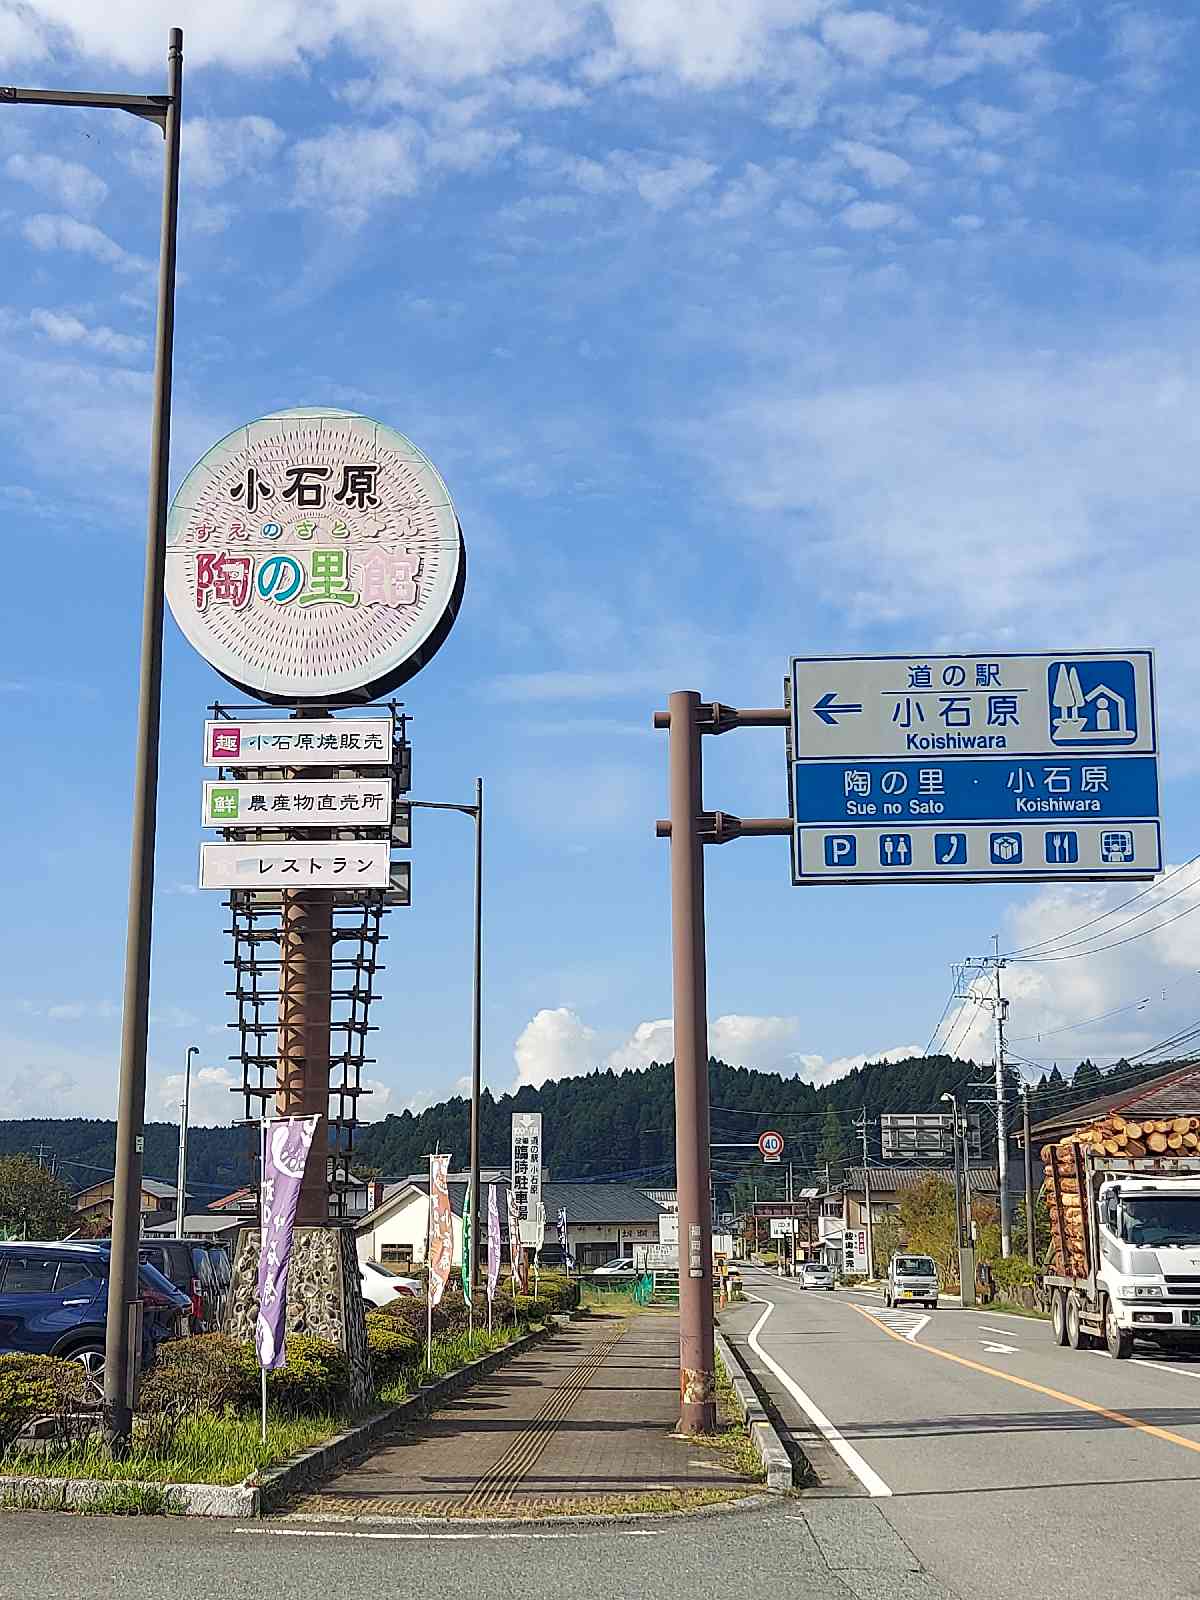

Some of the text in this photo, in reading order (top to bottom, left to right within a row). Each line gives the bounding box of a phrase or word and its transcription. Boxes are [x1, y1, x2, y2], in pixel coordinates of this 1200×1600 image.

[230, 464, 383, 510] 小石原
[908, 663, 1001, 689] 道の駅
[892, 695, 1020, 728] 小石原
[249, 733, 384, 751] 小石原焼販売
[906, 732, 1007, 751] Koishiwara
[844, 766, 1109, 796] 陶の里 小石原
[213, 793, 384, 814] 鮮 農産物直売所
[846, 797, 1101, 815] Sue no Sato Koishiwara
[258, 857, 375, 874] レストラン
[765, 1138, 778, 1150] 40
